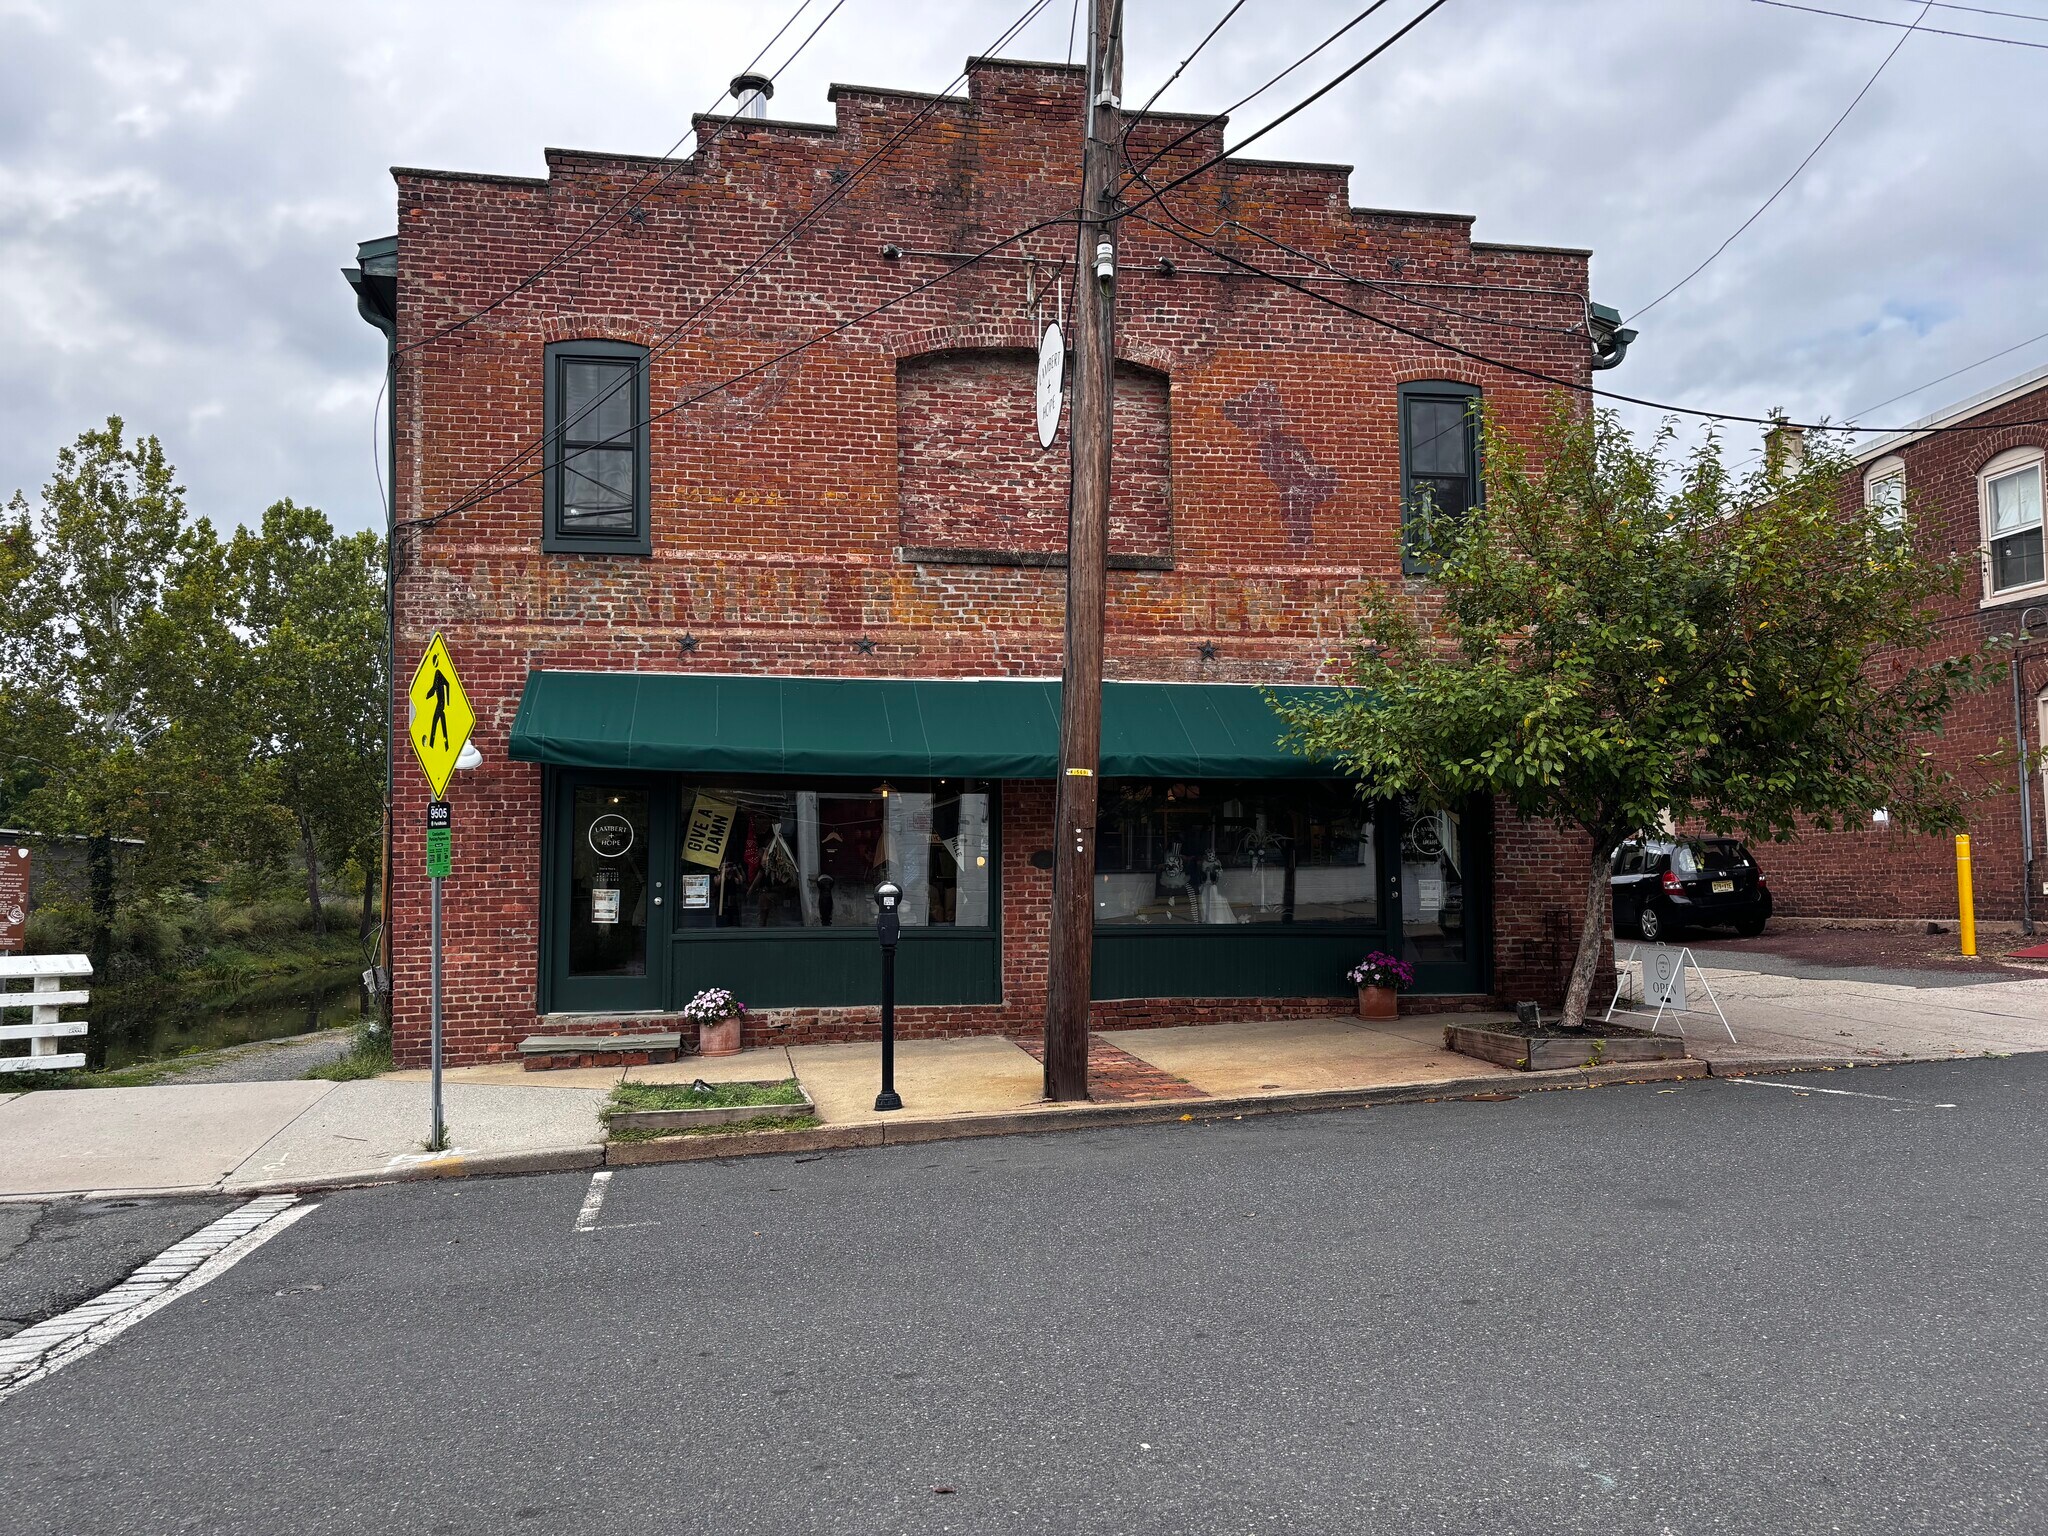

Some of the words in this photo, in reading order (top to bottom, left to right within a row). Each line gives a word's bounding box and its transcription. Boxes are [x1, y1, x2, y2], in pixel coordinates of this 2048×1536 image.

[1039, 351, 1061, 386] LAMBERT
[1042, 394, 1056, 421] HOPE
[698, 809, 713, 818] A
[688, 820, 709, 852] GIVE
[704, 815, 728, 854] DAMN
[1653, 981, 1677, 995] OPEN
